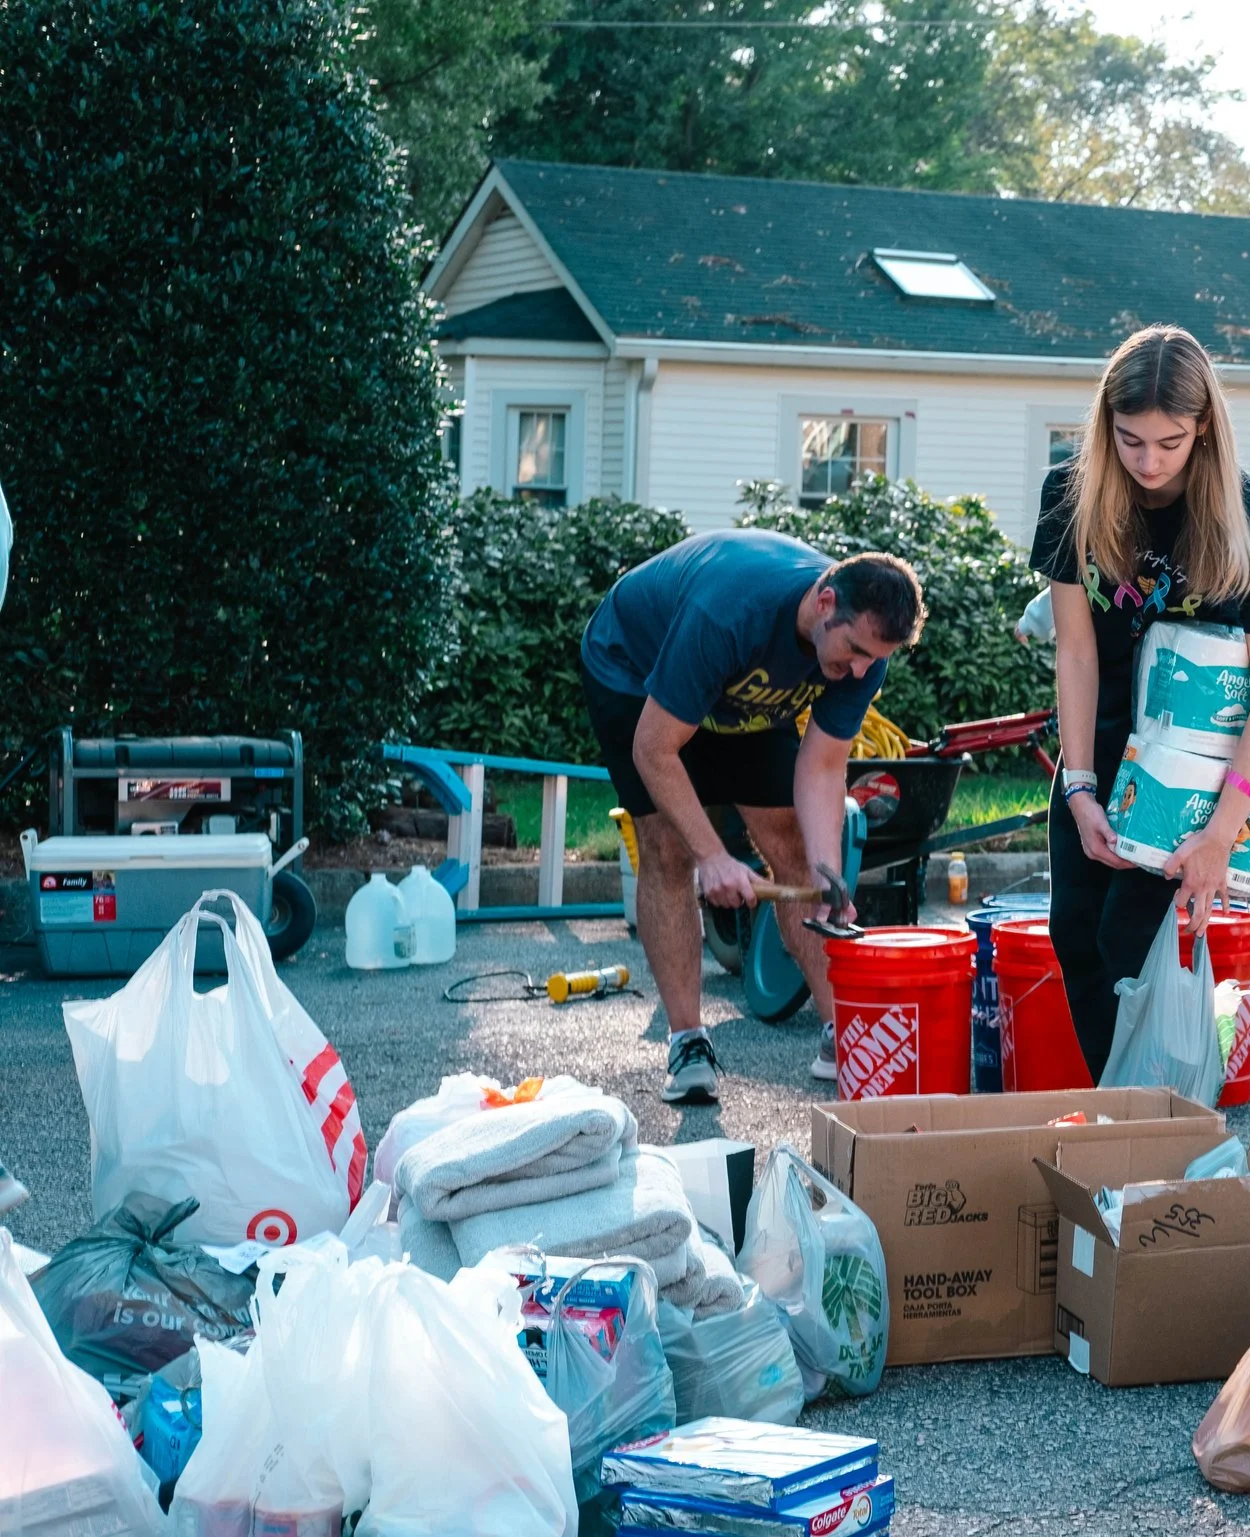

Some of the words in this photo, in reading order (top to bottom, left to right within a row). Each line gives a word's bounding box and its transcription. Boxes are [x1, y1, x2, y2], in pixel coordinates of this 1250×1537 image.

[1224, 684, 1248, 702] Soft
[1186, 793, 1219, 813] Ange
[62, 877, 88, 888] Family
[839, 1014, 869, 1053] THE
[838, 1005, 917, 1100] HOME
[860, 1042, 917, 1100] DEPOT
[906, 1189, 949, 1208] BIG
[904, 1207, 951, 1226] RED
[951, 1212, 989, 1223] JACKS
[903, 1269, 993, 1288] HAND-AWAY
[903, 1287, 943, 1301] TOOL
[947, 1284, 977, 1297] BOX
[903, 1308, 962, 1320] HERRAMIENTAS
[927, 1301, 953, 1311] PORTA
[113, 1301, 134, 1325] is
[142, 1311, 186, 1331] our
[811, 1506, 848, 1532] Colgate
